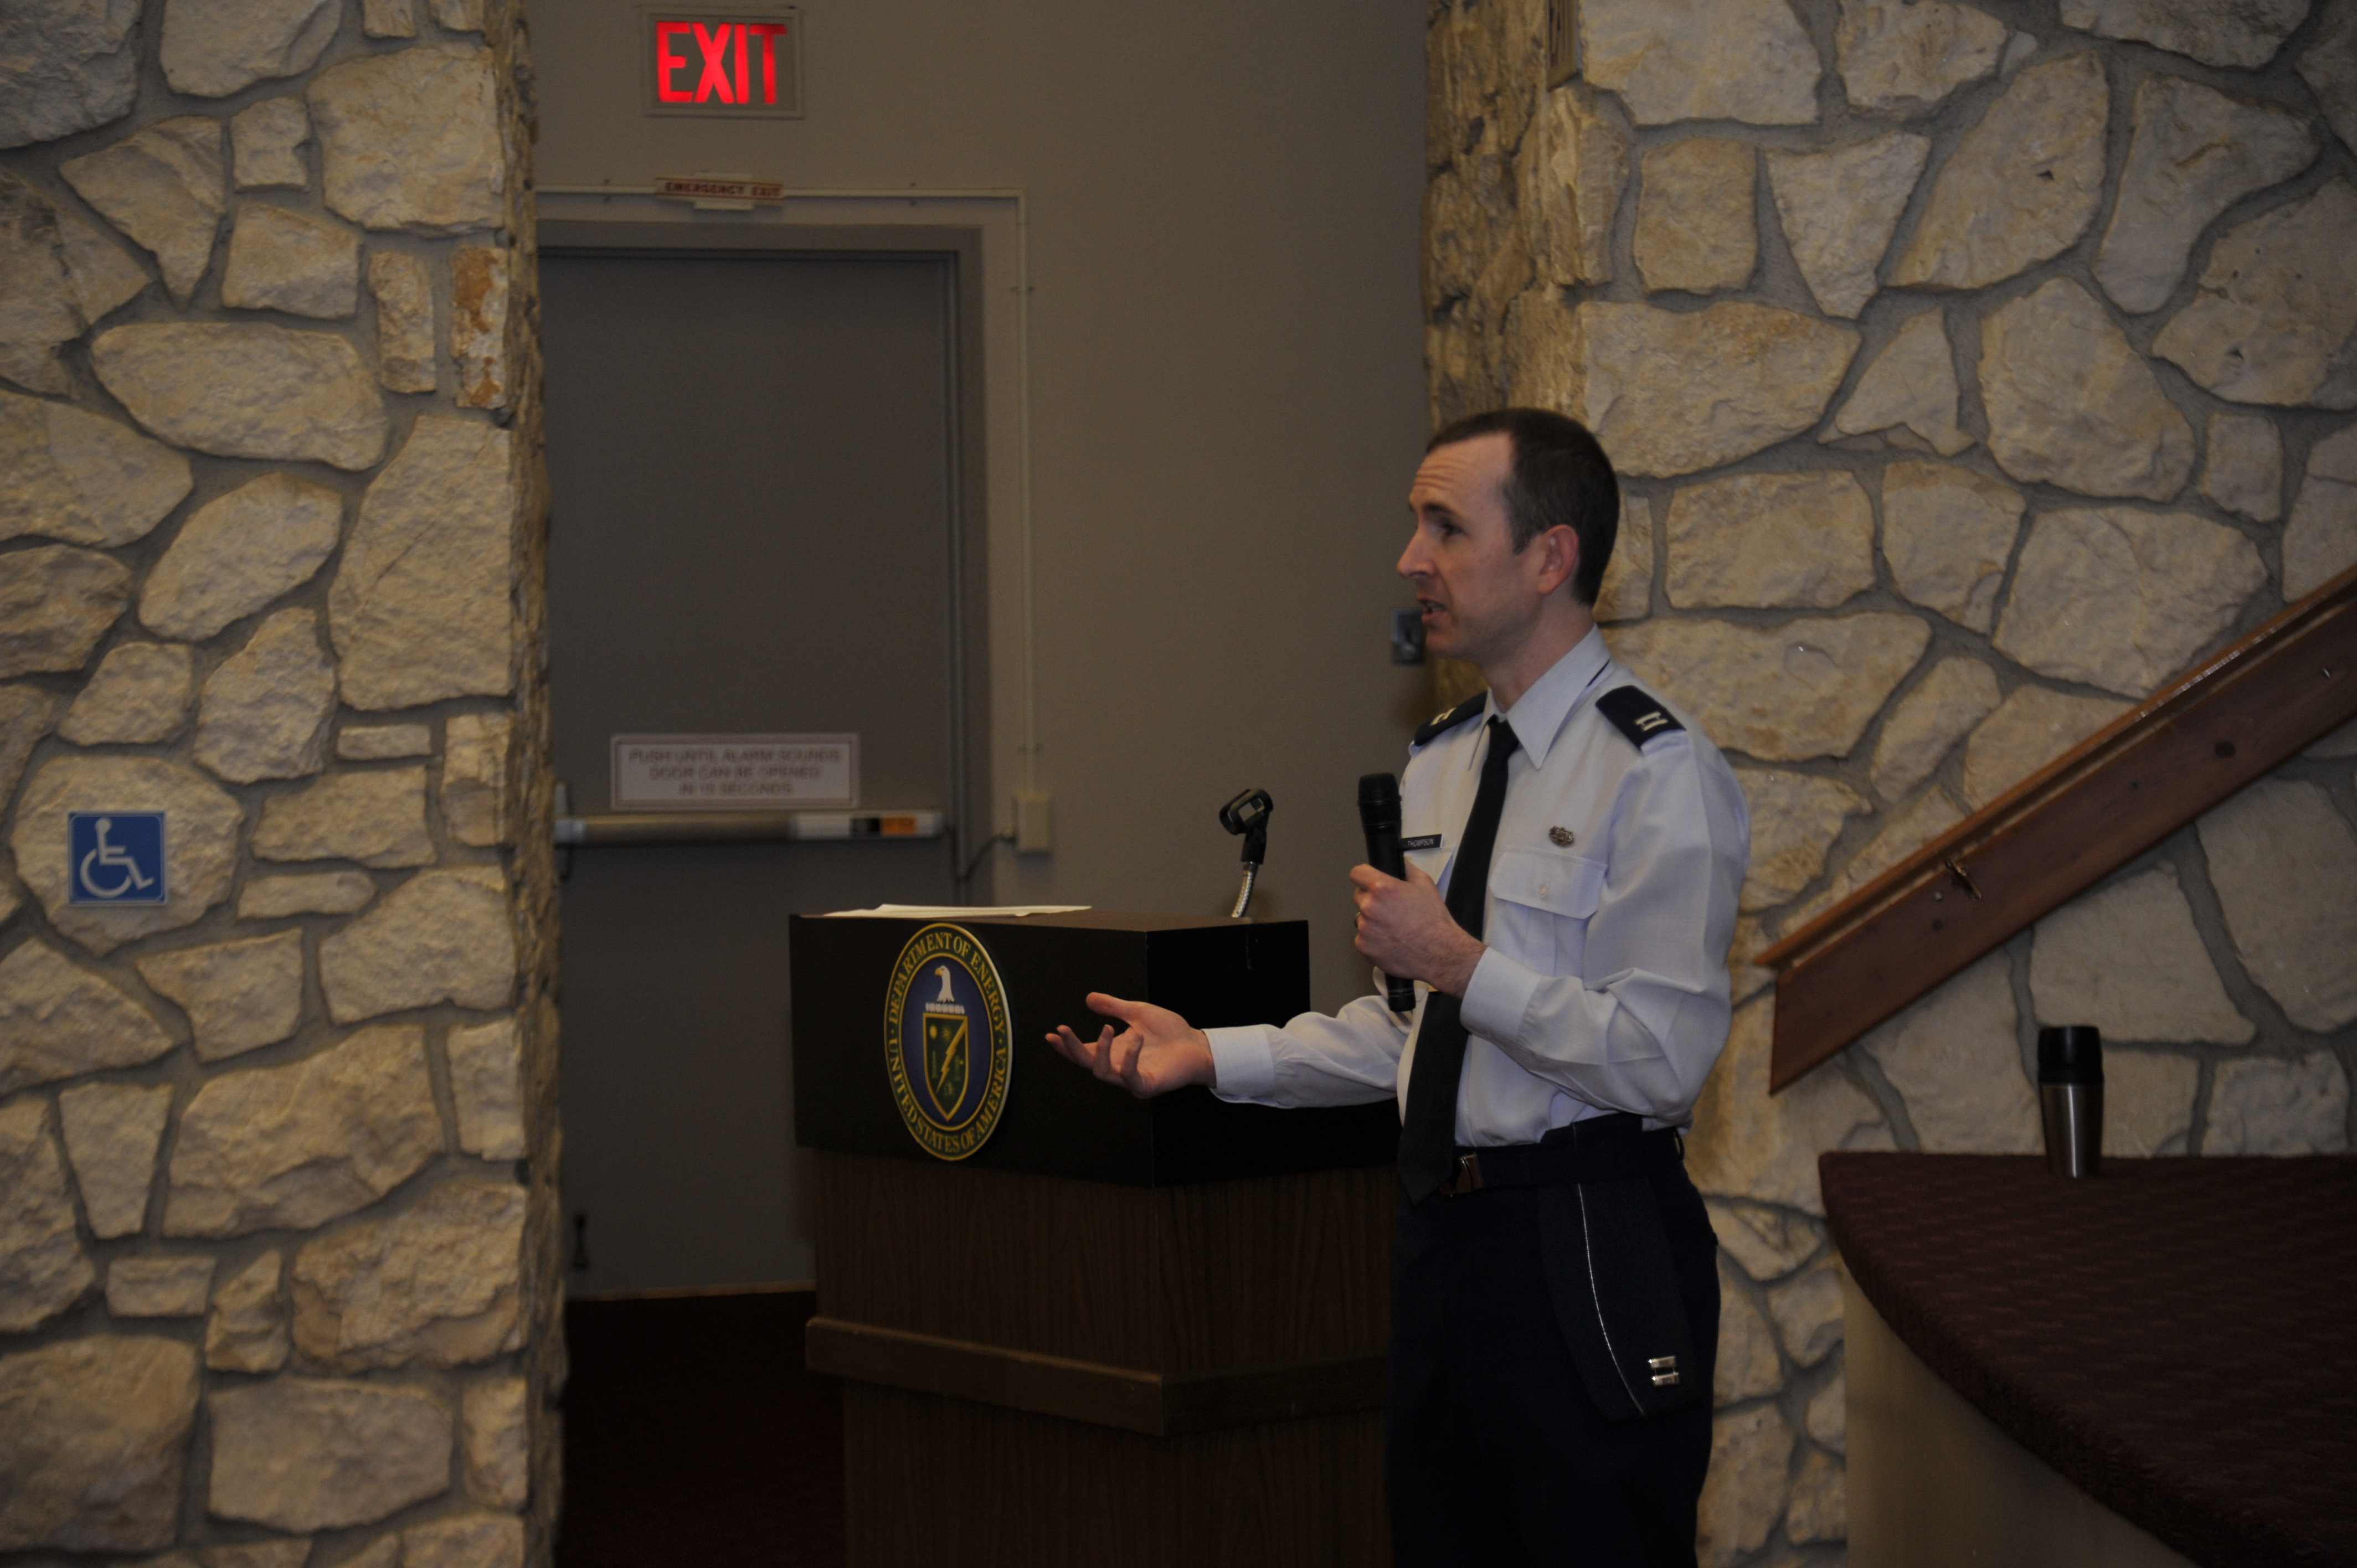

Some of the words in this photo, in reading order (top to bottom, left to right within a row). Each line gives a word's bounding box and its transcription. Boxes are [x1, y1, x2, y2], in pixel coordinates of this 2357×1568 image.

[656, 20, 787, 104] EXIT
[665, 182, 745, 194] EMERGENCY
[750, 187, 781, 196] EXIT
[629, 748, 671, 762] PUSH
[680, 748, 715, 762] UNTIL
[722, 748, 774, 762] ALARM
[779, 749, 840, 762] SOUNDS
[650, 766, 693, 780] DOOR
[698, 766, 730, 780] CAN
[734, 766, 752, 779] BE
[758, 766, 821, 780] OPENED
[679, 783, 694, 795] IN
[719, 783, 791, 796] SECONDS
[888, 932, 953, 1025] DEPARTMENT
[953, 935, 971, 958] OF
[970, 950, 1006, 1035] ENERGY
[888, 1036, 918, 1124] UNITED
[915, 1119, 961, 1154] STATES
[960, 1128, 976, 1148] OF
[975, 1046, 1007, 1141] AMERICA
